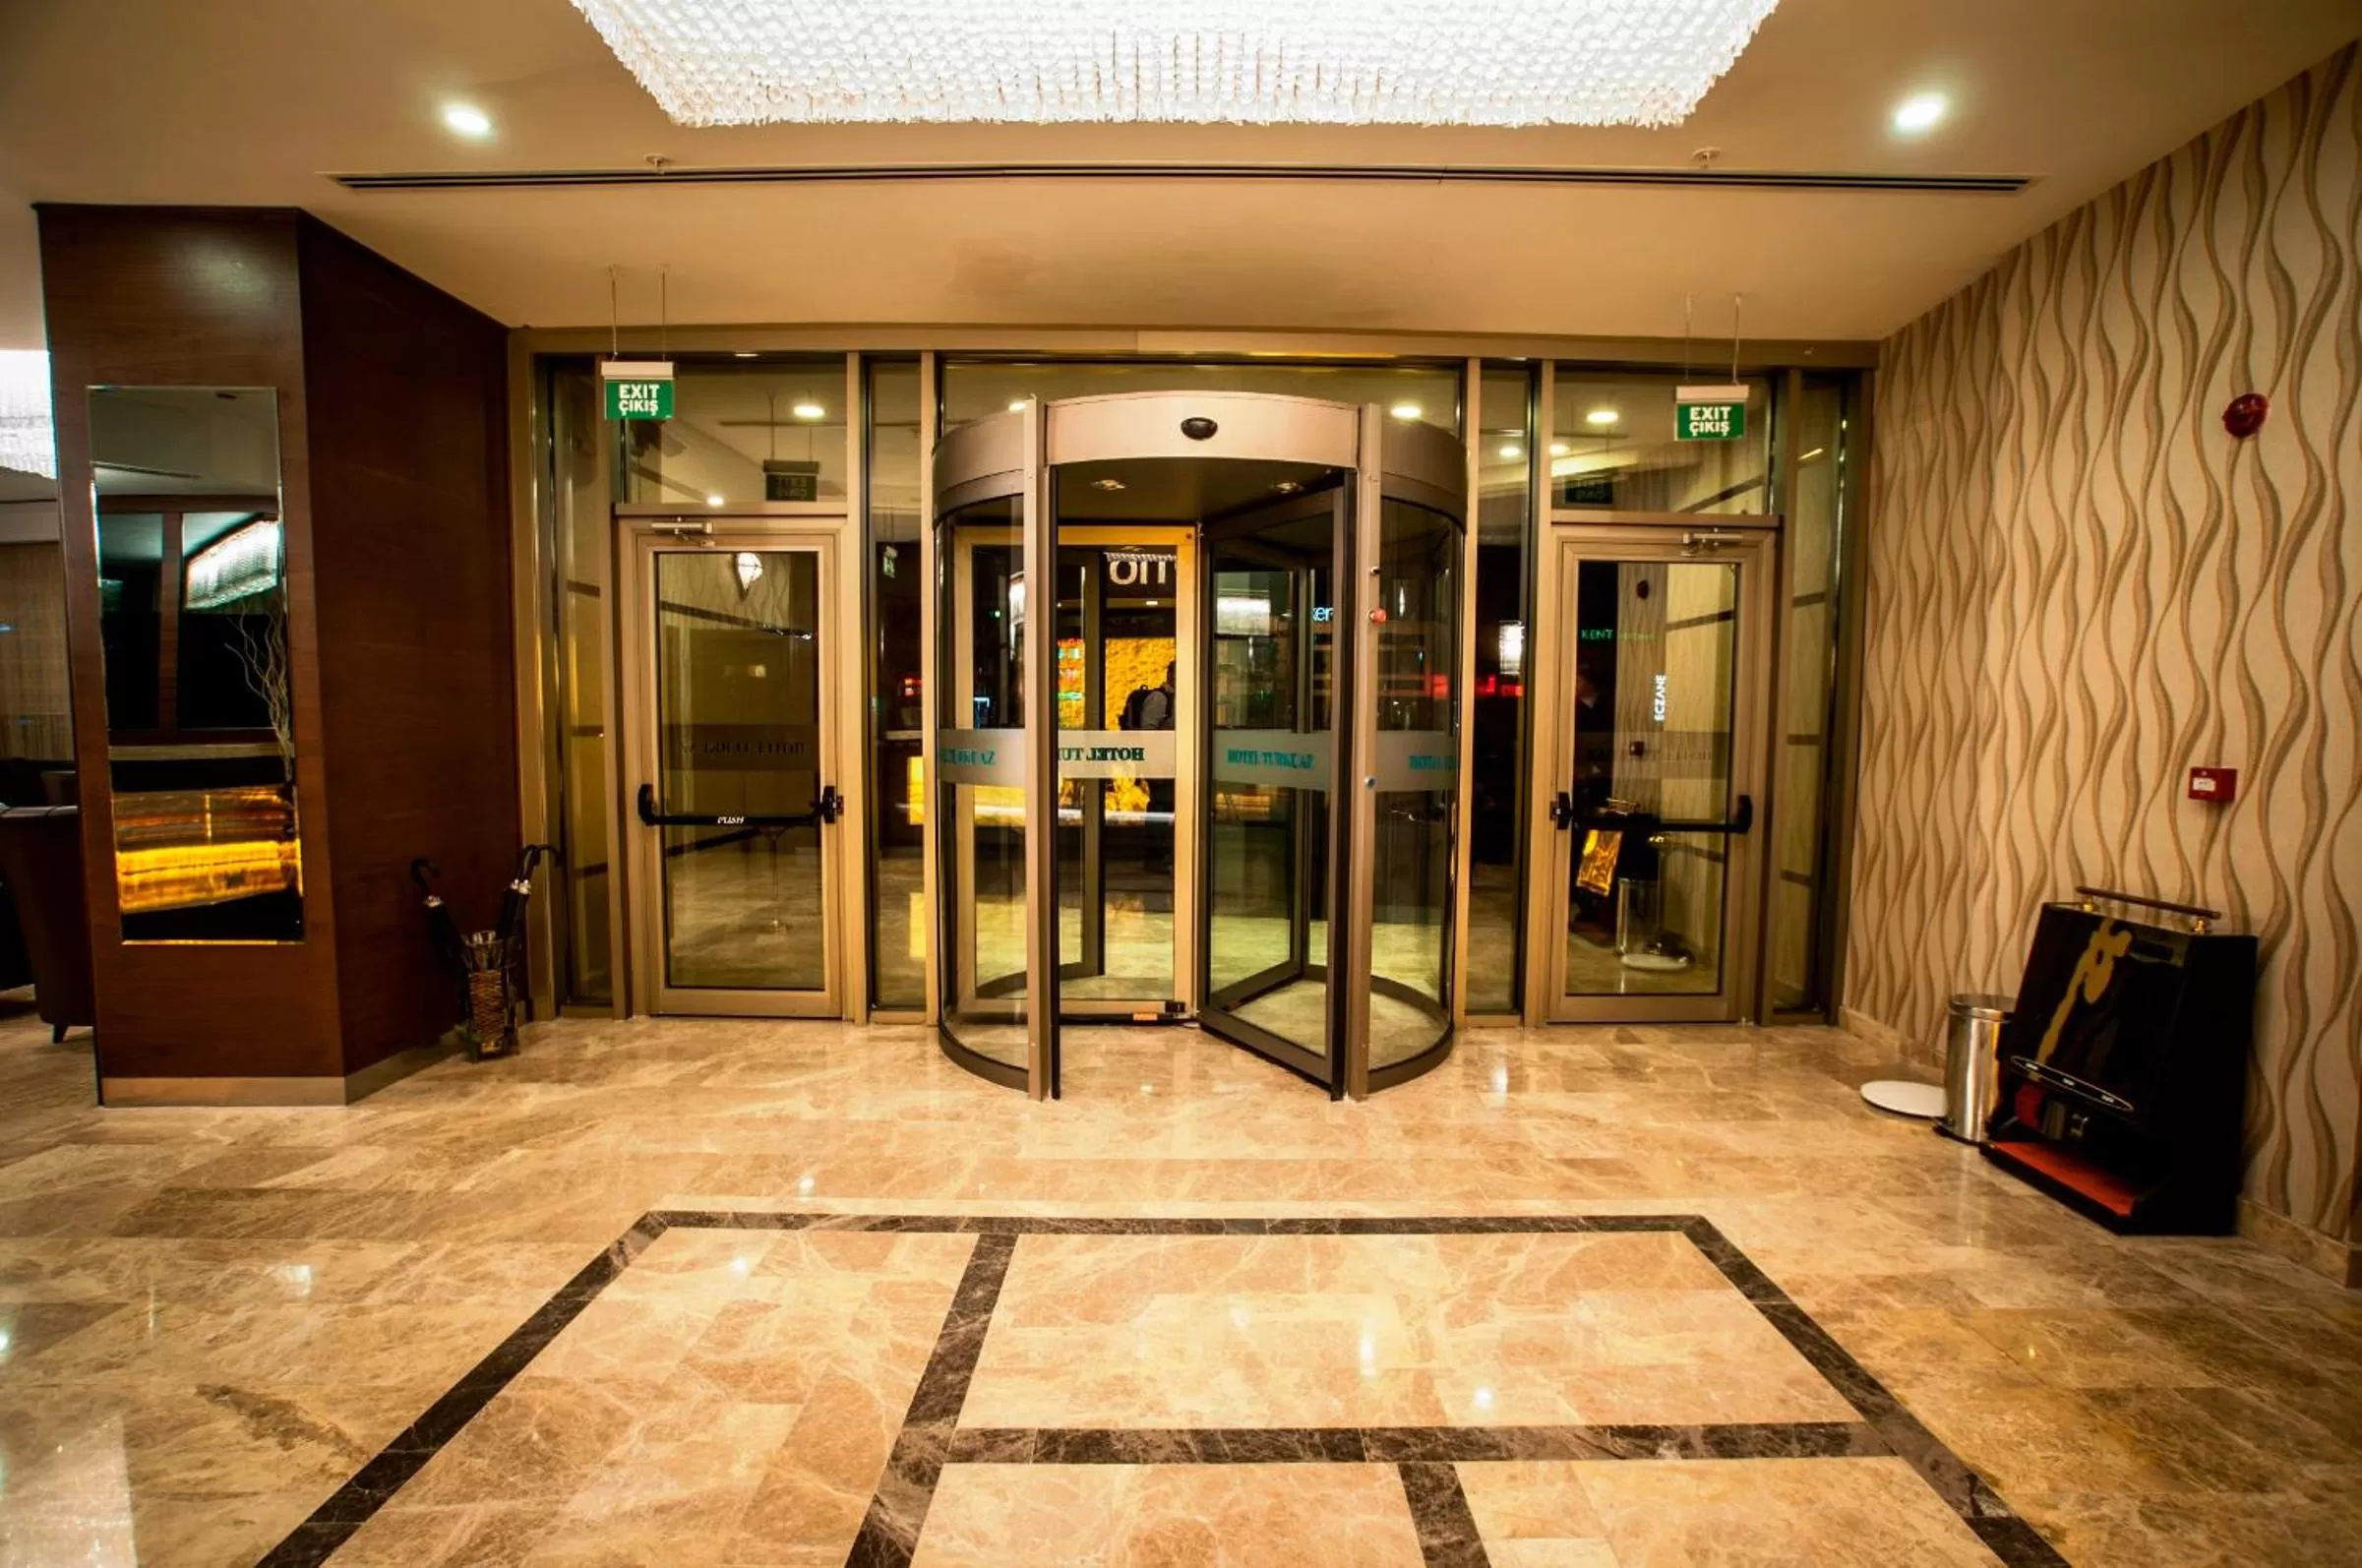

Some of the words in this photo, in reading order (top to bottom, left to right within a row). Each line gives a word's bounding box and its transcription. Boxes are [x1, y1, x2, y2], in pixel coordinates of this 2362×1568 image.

[619, 384, 660, 398] EXIT
[618, 399, 659, 416] ÇIKIŞ
[1690, 406, 1731, 420] EXIT
[1689, 421, 1729, 437] ÇIKIŞ
[1580, 629, 1613, 640] KENT
[1654, 674, 1666, 721] ECZANE
